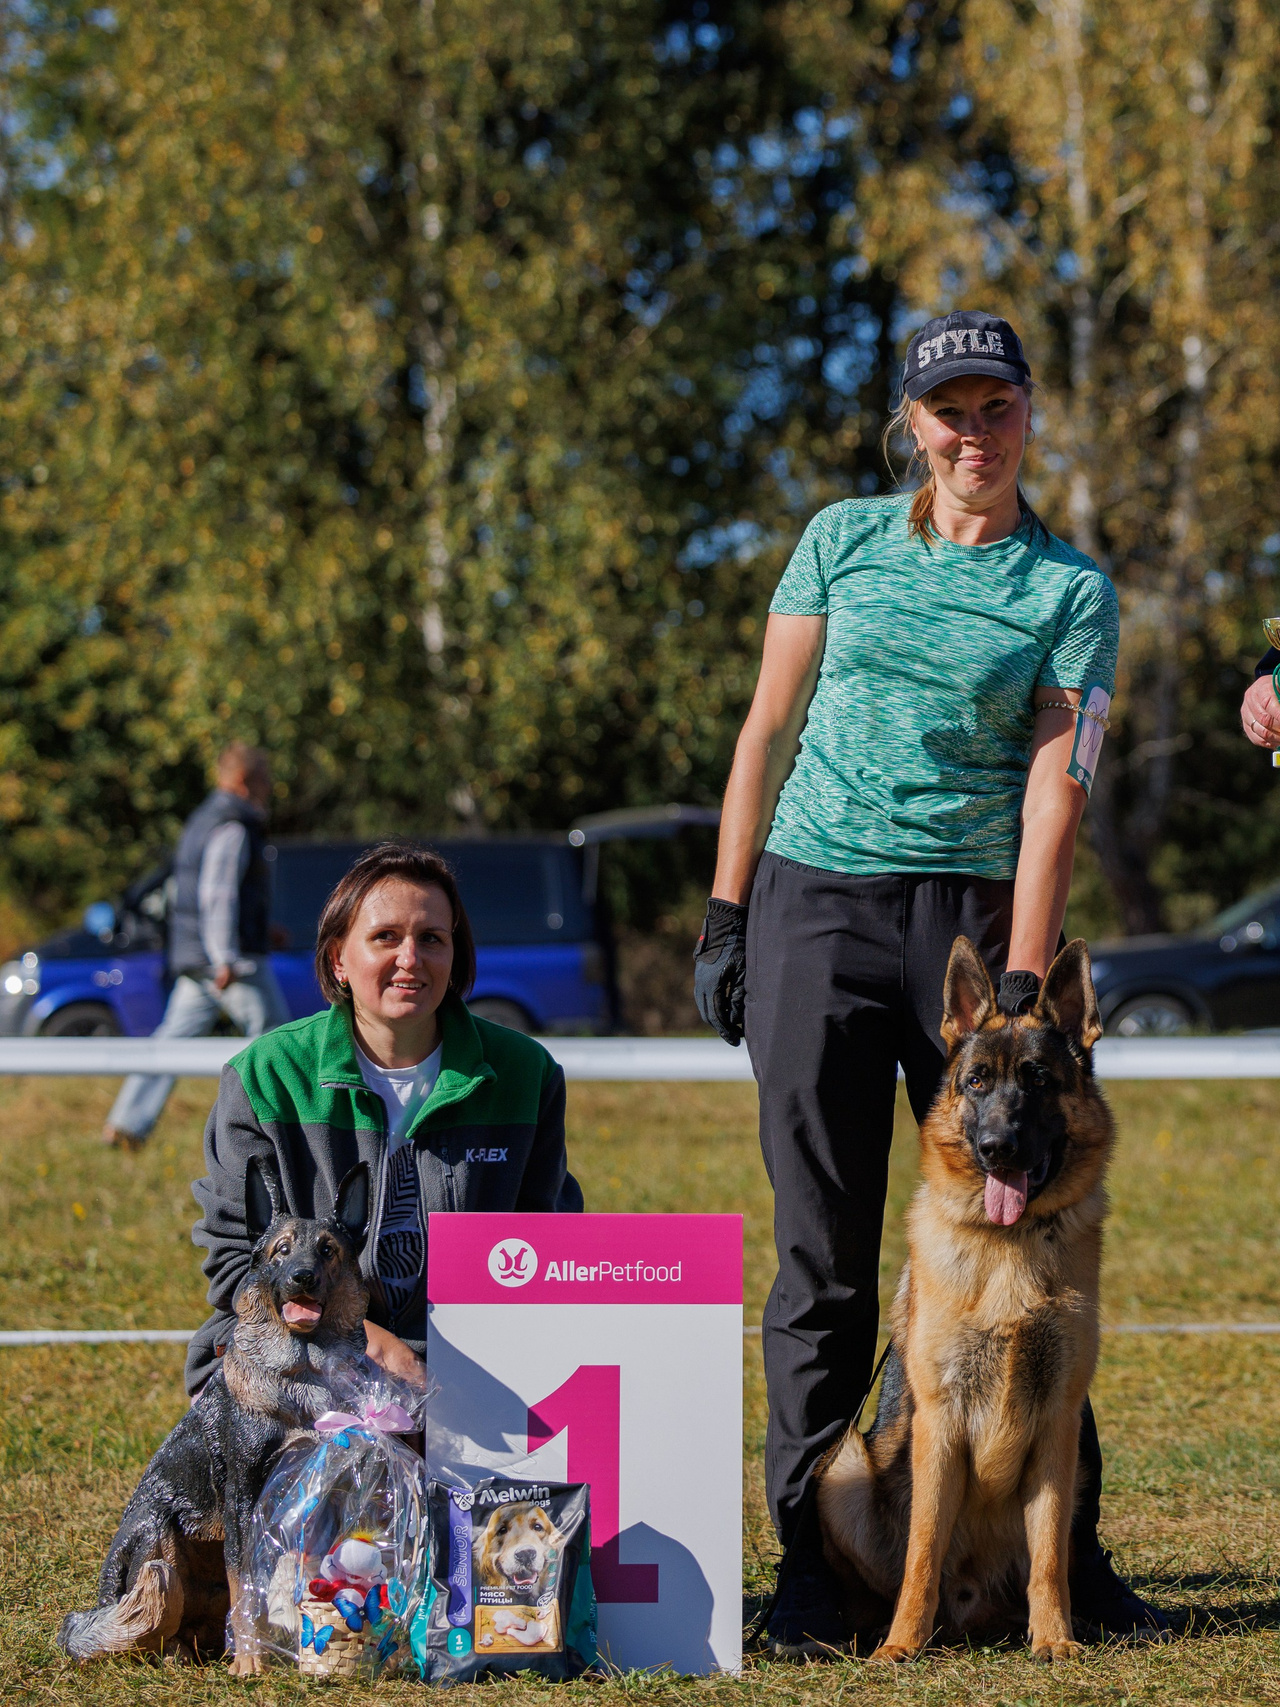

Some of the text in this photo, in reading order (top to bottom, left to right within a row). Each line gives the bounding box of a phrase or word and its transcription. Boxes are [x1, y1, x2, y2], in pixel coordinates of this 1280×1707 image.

[917, 329, 1005, 369] STYLE
[465, 1147, 509, 1163] K-FLEX
[544, 1260, 682, 1283] AllerPetfood
[527, 1364, 659, 1603] 1
[479, 1485, 551, 1504] Melwin
[529, 1498, 551, 1508] dogs
[453, 1525, 468, 1587] SENIOR
[455, 1634, 463, 1645] 1
